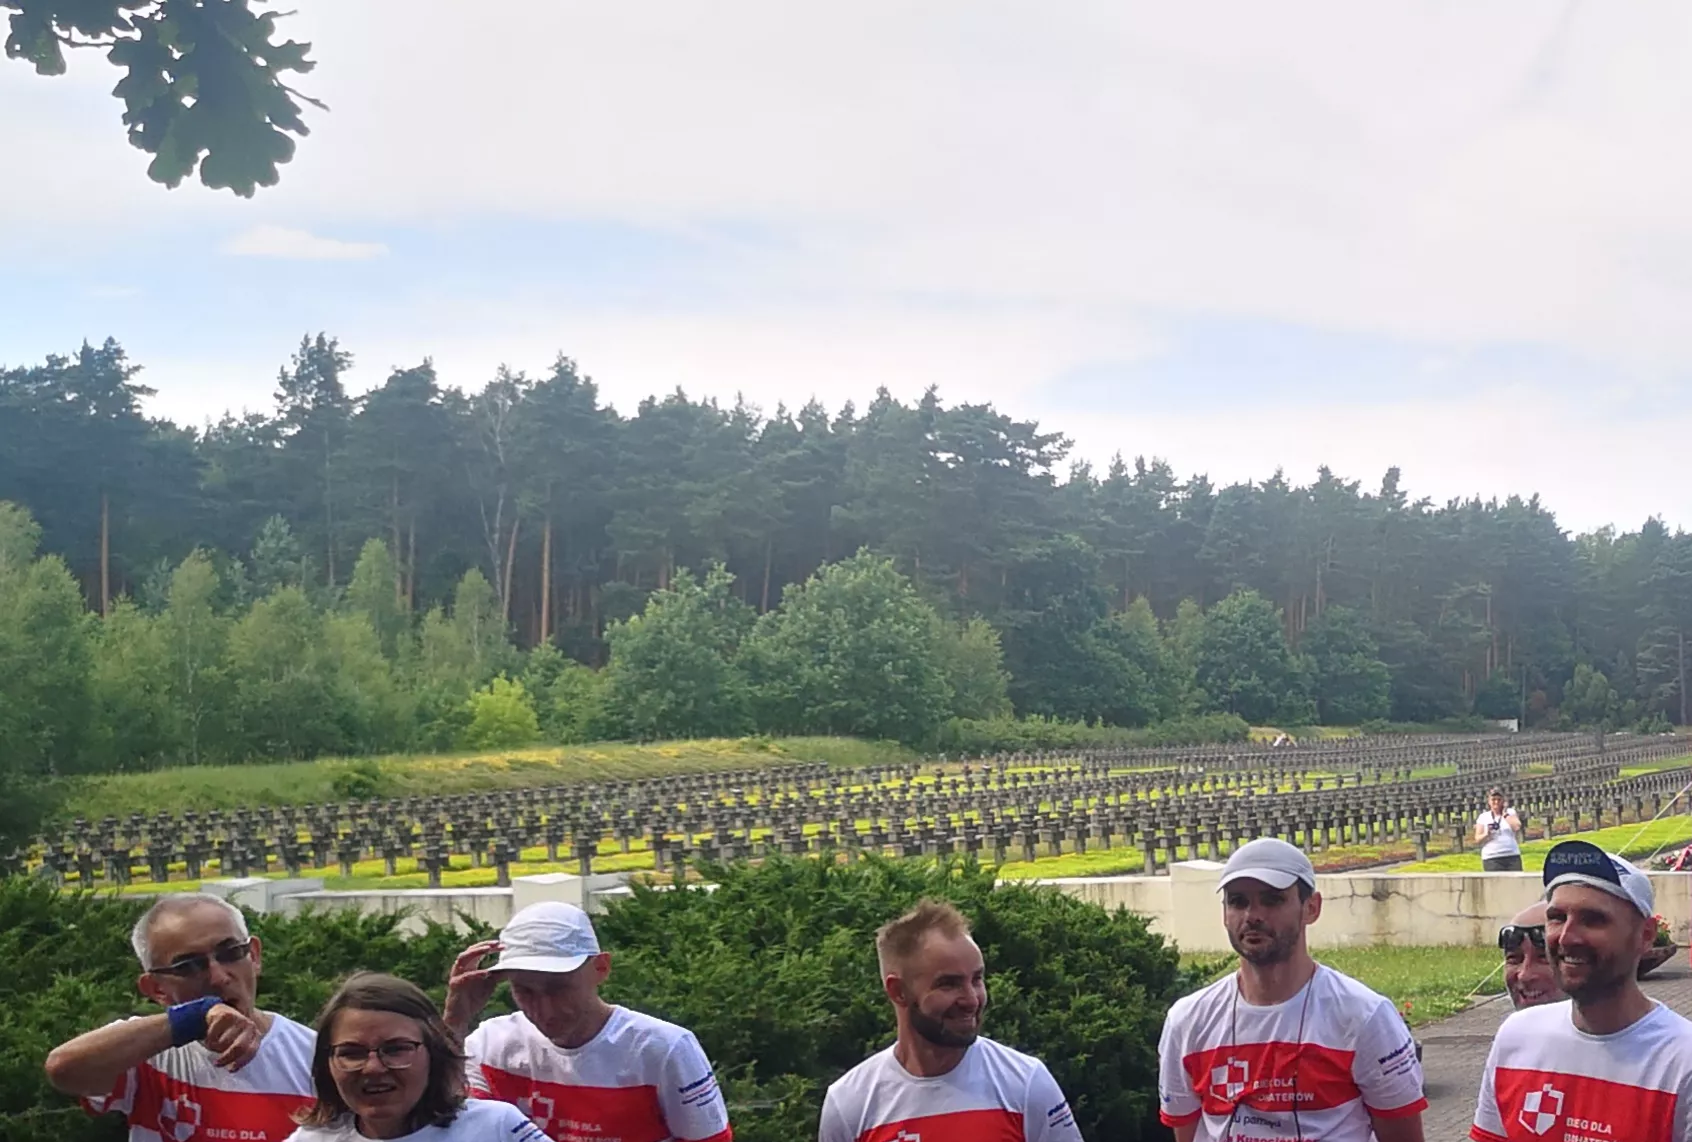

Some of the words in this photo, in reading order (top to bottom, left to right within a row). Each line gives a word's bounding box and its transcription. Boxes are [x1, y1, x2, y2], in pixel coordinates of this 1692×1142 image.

[1590, 1121, 1612, 1134] DLA
[206, 1128, 237, 1140] BIEG
[240, 1130, 267, 1141] DLA
